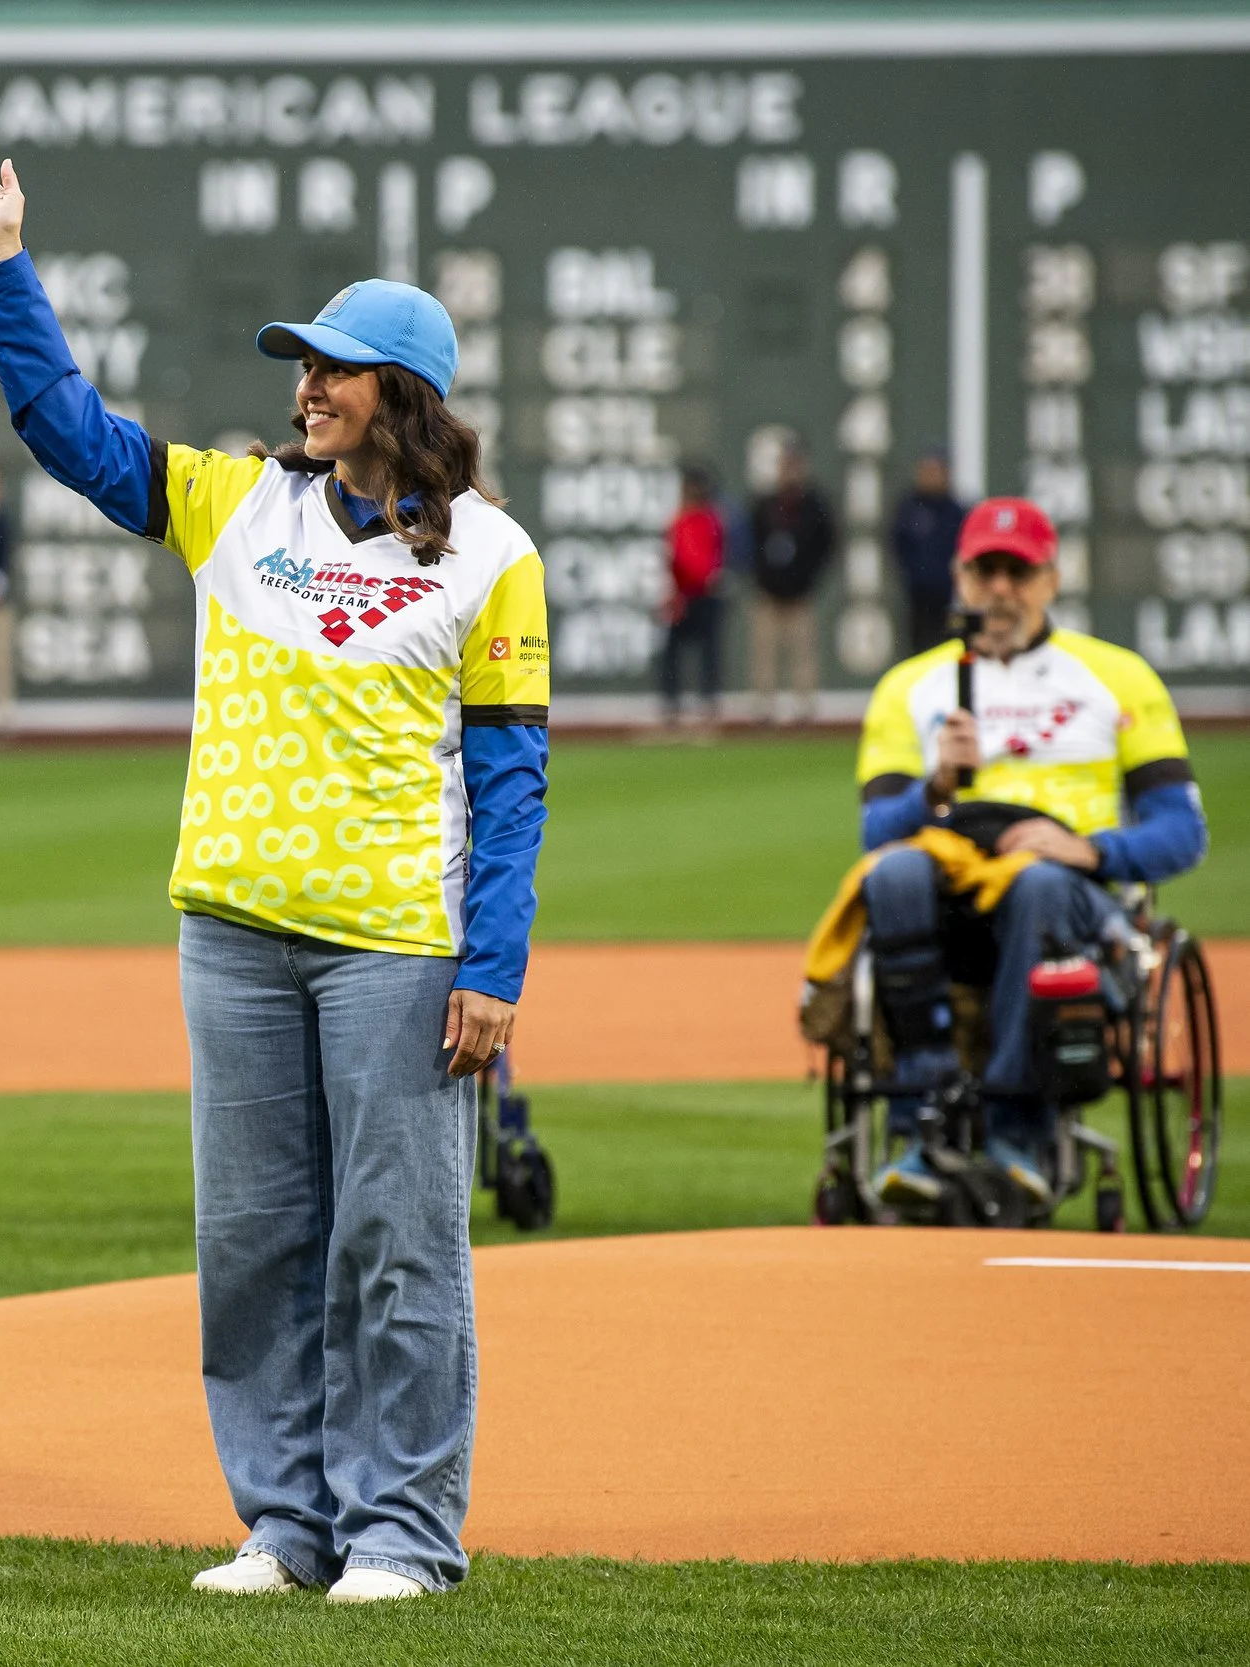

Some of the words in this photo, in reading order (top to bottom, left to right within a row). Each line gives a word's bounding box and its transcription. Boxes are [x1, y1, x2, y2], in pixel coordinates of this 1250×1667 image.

[468, 70, 804, 148] LEAGUE
[197, 156, 282, 236] IN
[297, 154, 360, 236] R
[434, 153, 496, 236] P
[735, 151, 817, 231] IN
[836, 148, 899, 230] R
[1026, 149, 1086, 227] P
[253, 547, 384, 598] Achilles
[260, 574, 324, 604] FREEDOM
[330, 594, 370, 609] TEAM
